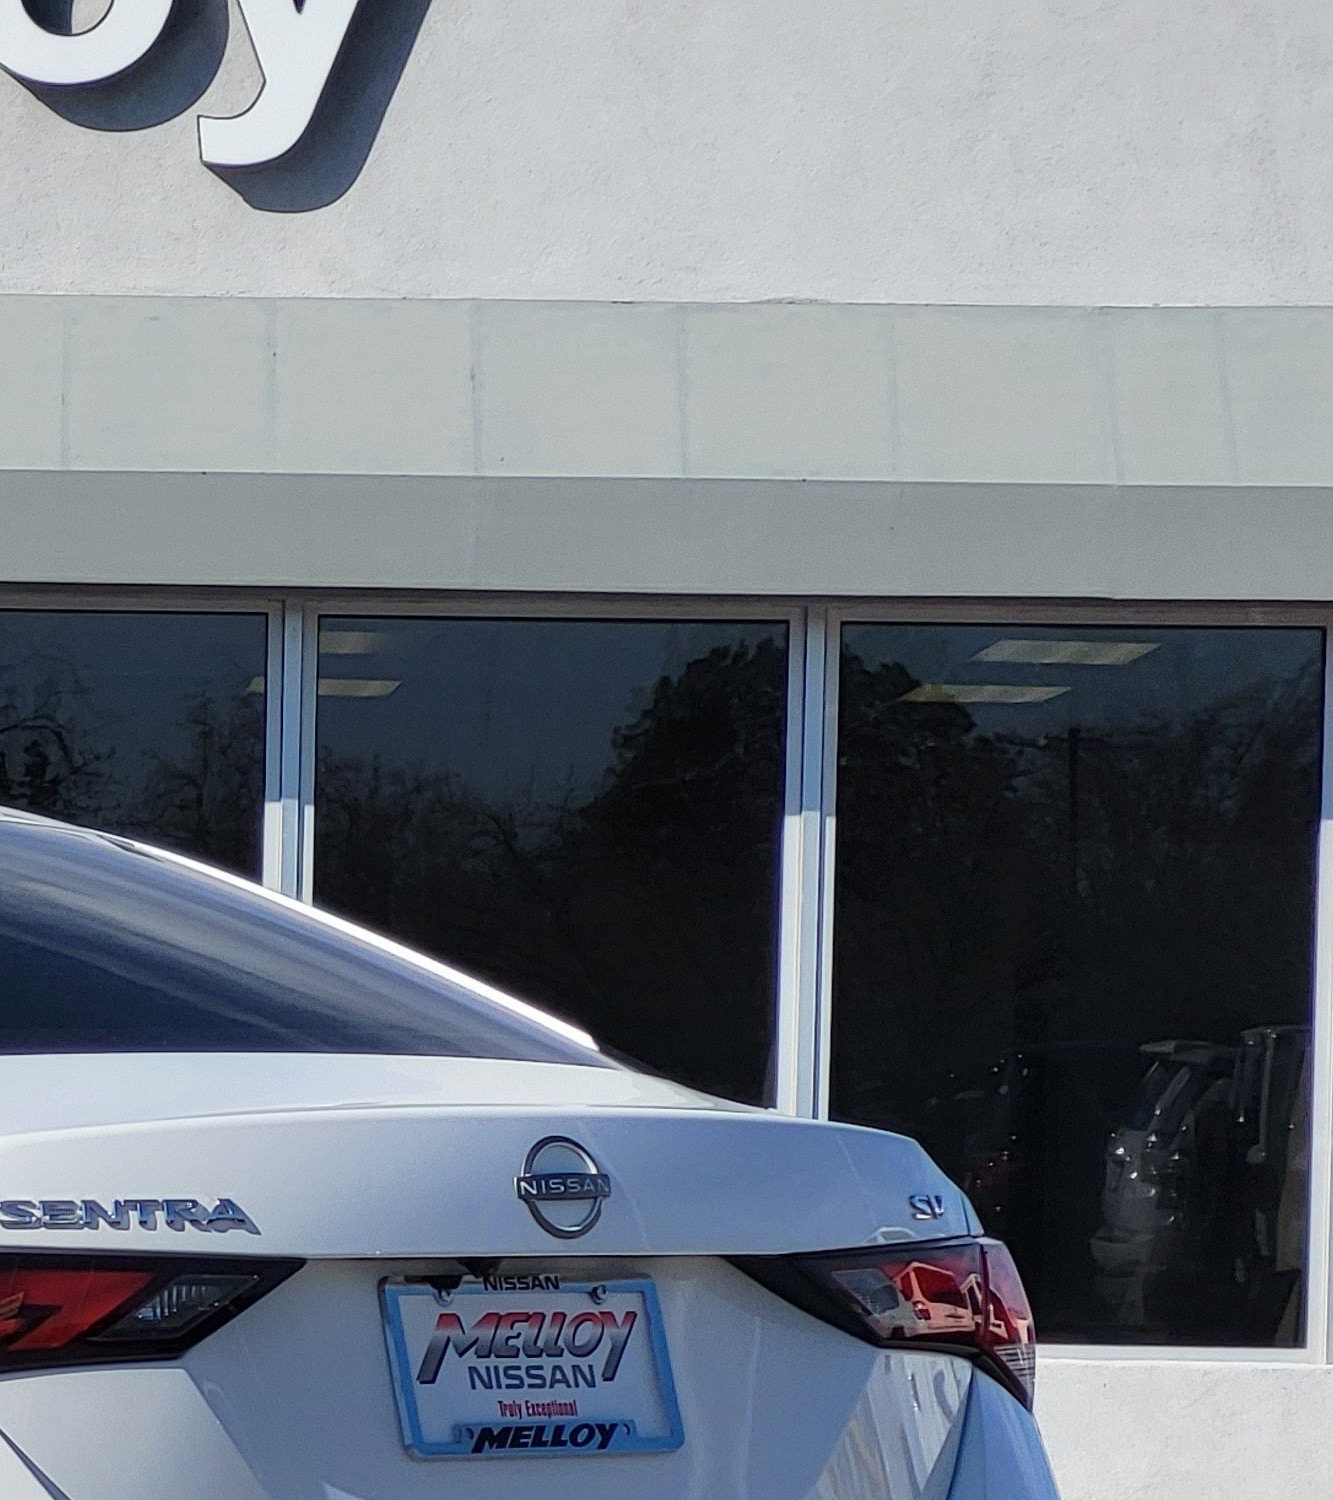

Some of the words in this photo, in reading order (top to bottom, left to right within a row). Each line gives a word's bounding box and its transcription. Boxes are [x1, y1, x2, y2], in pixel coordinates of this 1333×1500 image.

[519, 1178, 610, 1195] NISSAN
[483, 1275, 560, 1291] NISSAN
[416, 1311, 637, 1384] MELLOY
[468, 1364, 597, 1390] NISSAN
[497, 1400, 522, 1419] Truly
[525, 1399, 579, 1419] Exceptional
[471, 1422, 619, 1453] MELLOY
